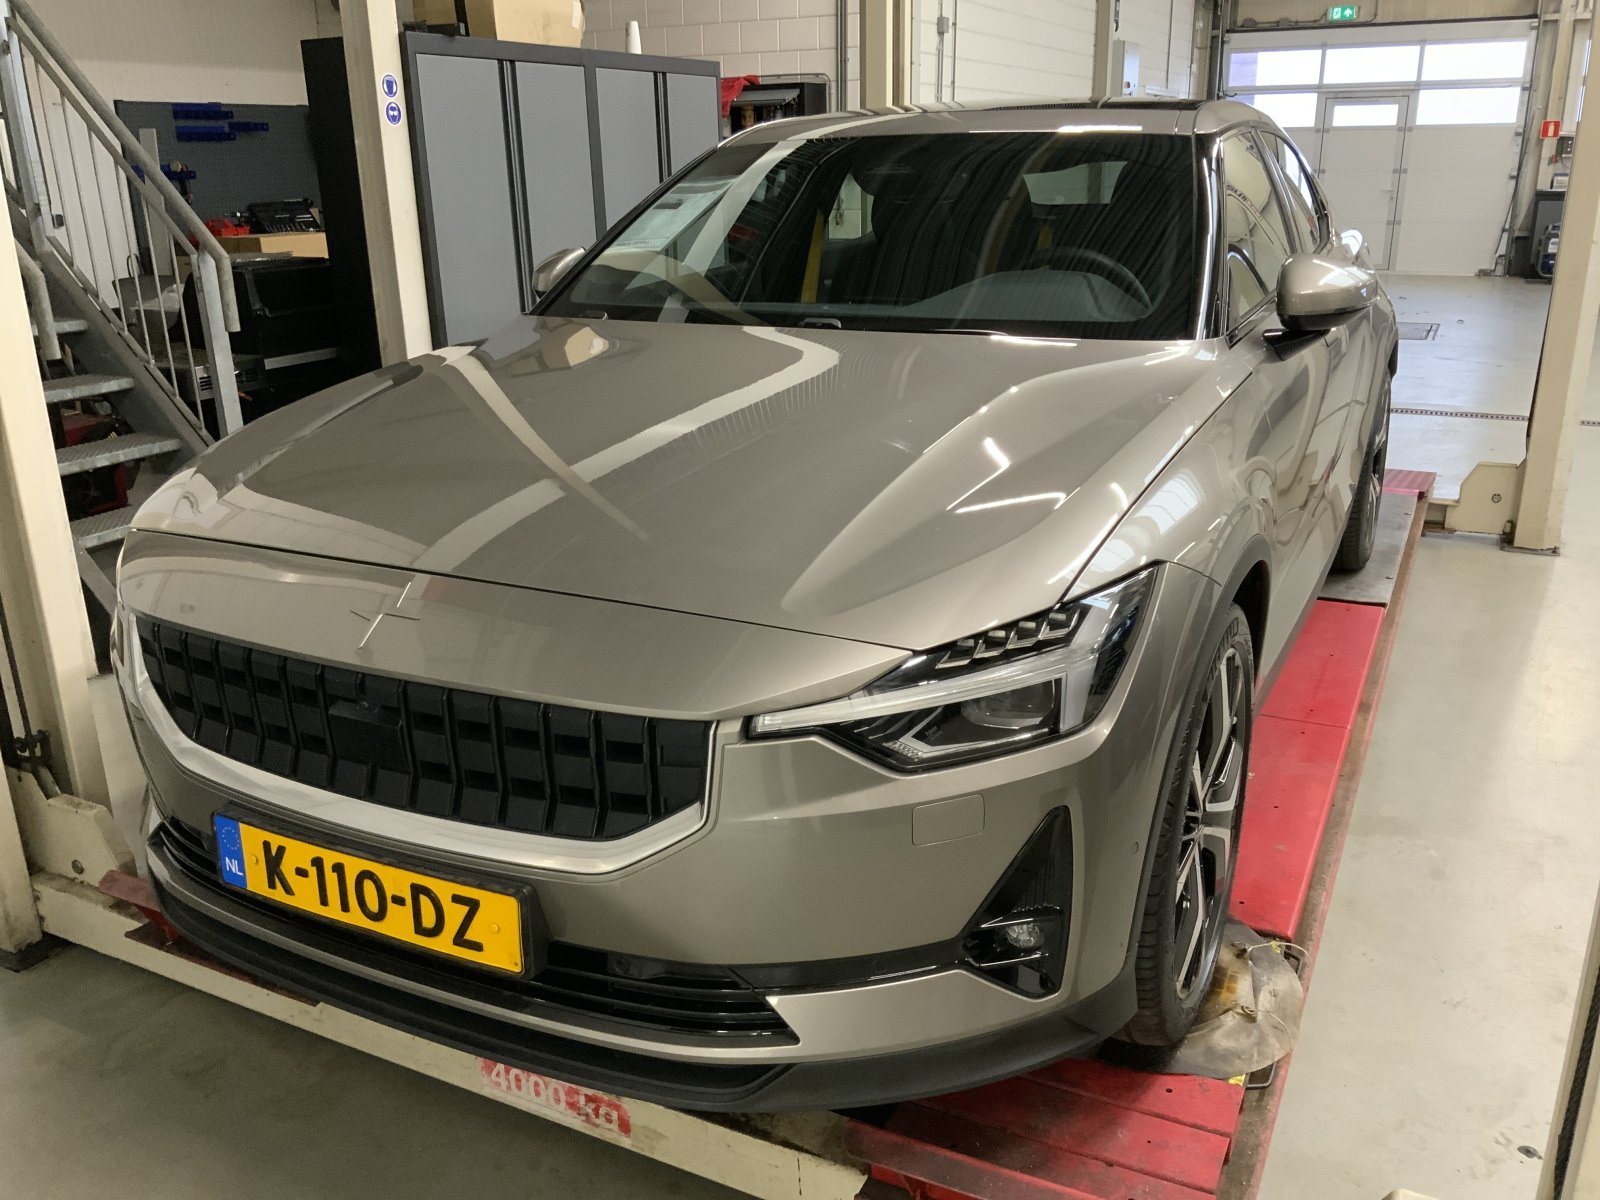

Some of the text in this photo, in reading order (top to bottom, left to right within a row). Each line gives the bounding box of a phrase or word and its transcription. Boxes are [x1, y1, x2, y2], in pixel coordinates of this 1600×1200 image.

[225, 856, 243, 877] NL
[263, 840, 484, 952] K-110-DZ
[490, 1062, 567, 1110] 4000
